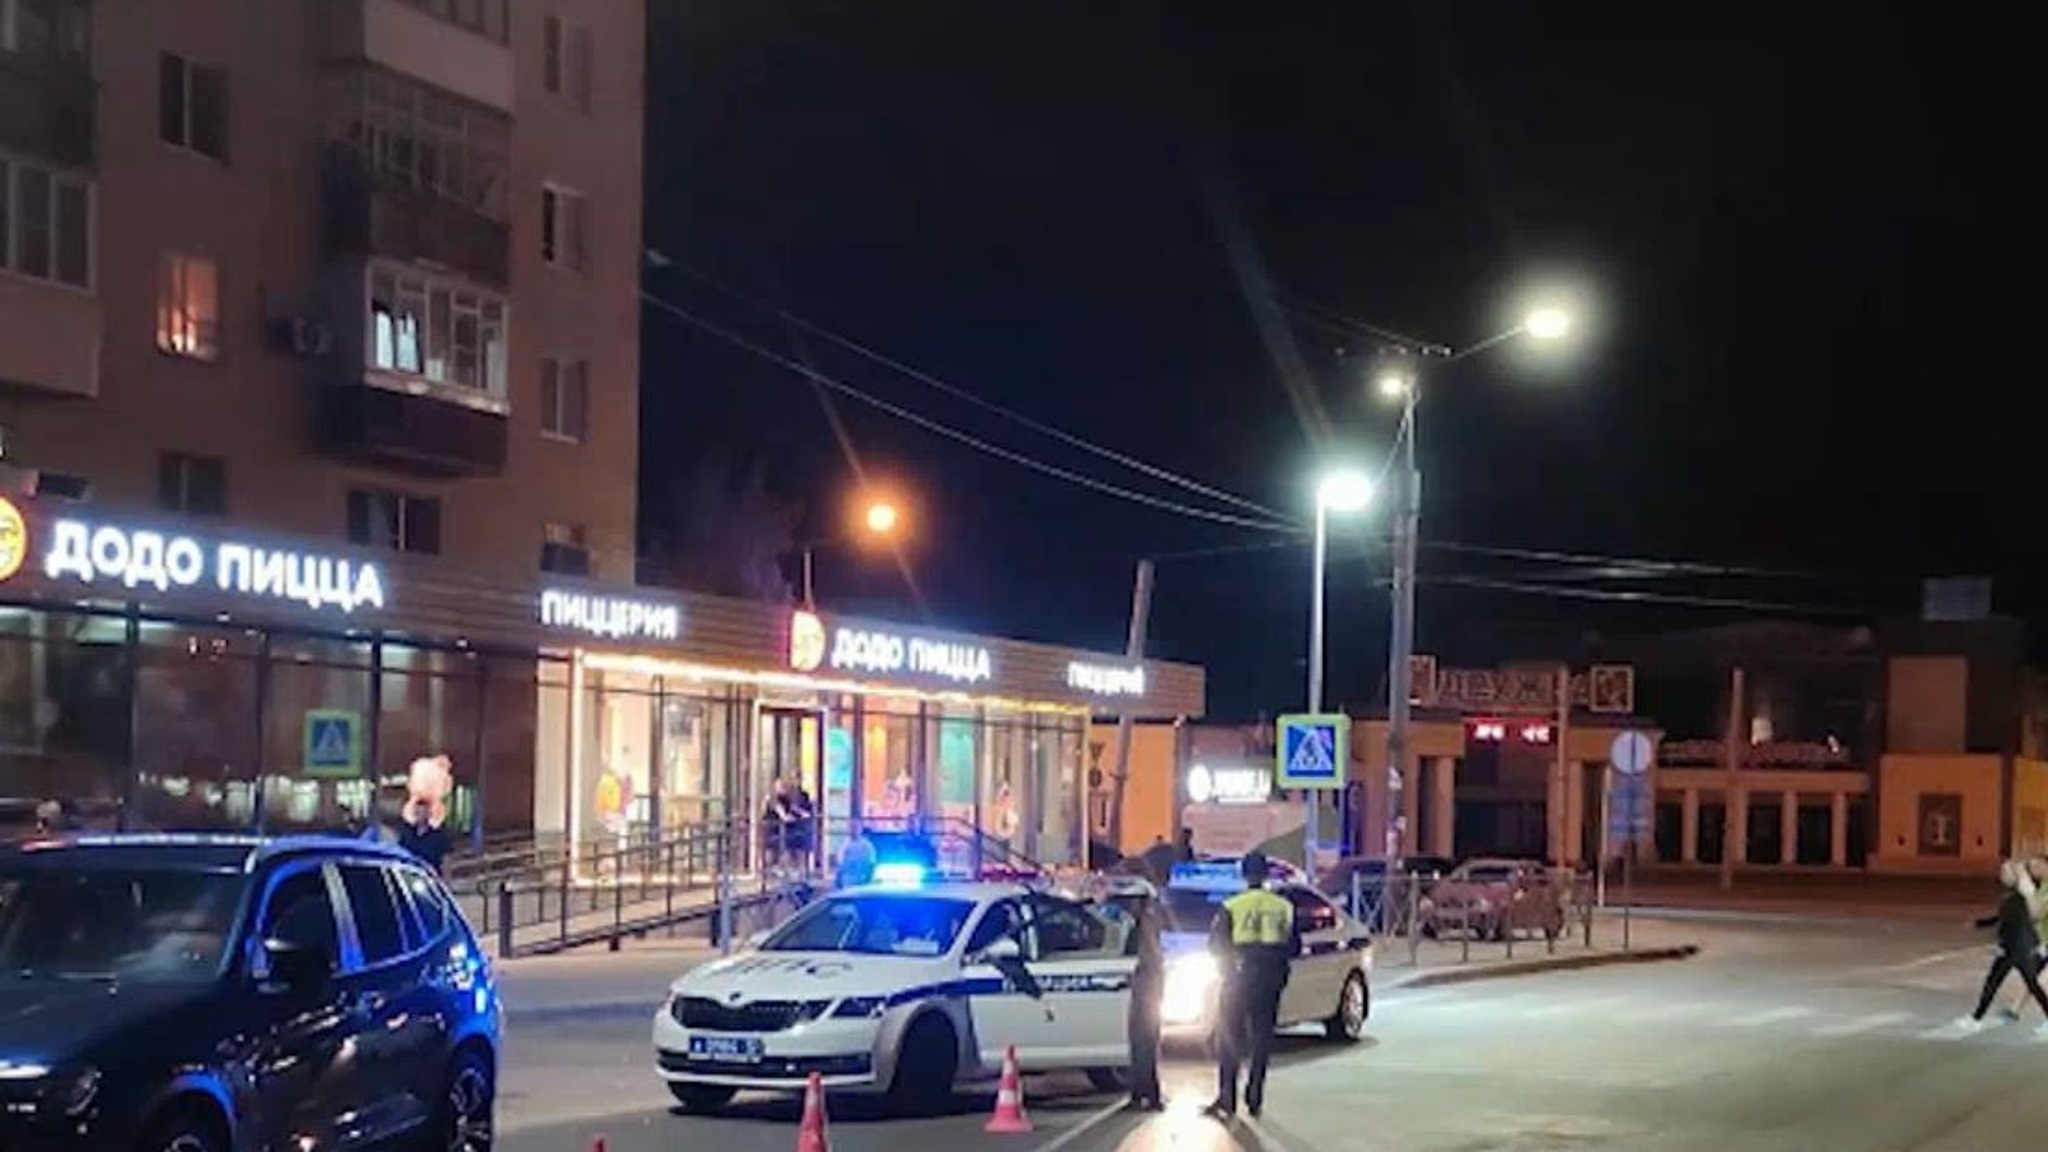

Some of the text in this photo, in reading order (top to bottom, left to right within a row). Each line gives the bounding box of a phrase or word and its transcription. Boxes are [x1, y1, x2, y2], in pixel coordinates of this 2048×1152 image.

[45, 519, 384, 613] ДОДО ПИЦЦА
[541, 589, 678, 640] ПИЦЦЕРИЯ
[830, 627, 992, 685] ДОДО ПИЦЦА
